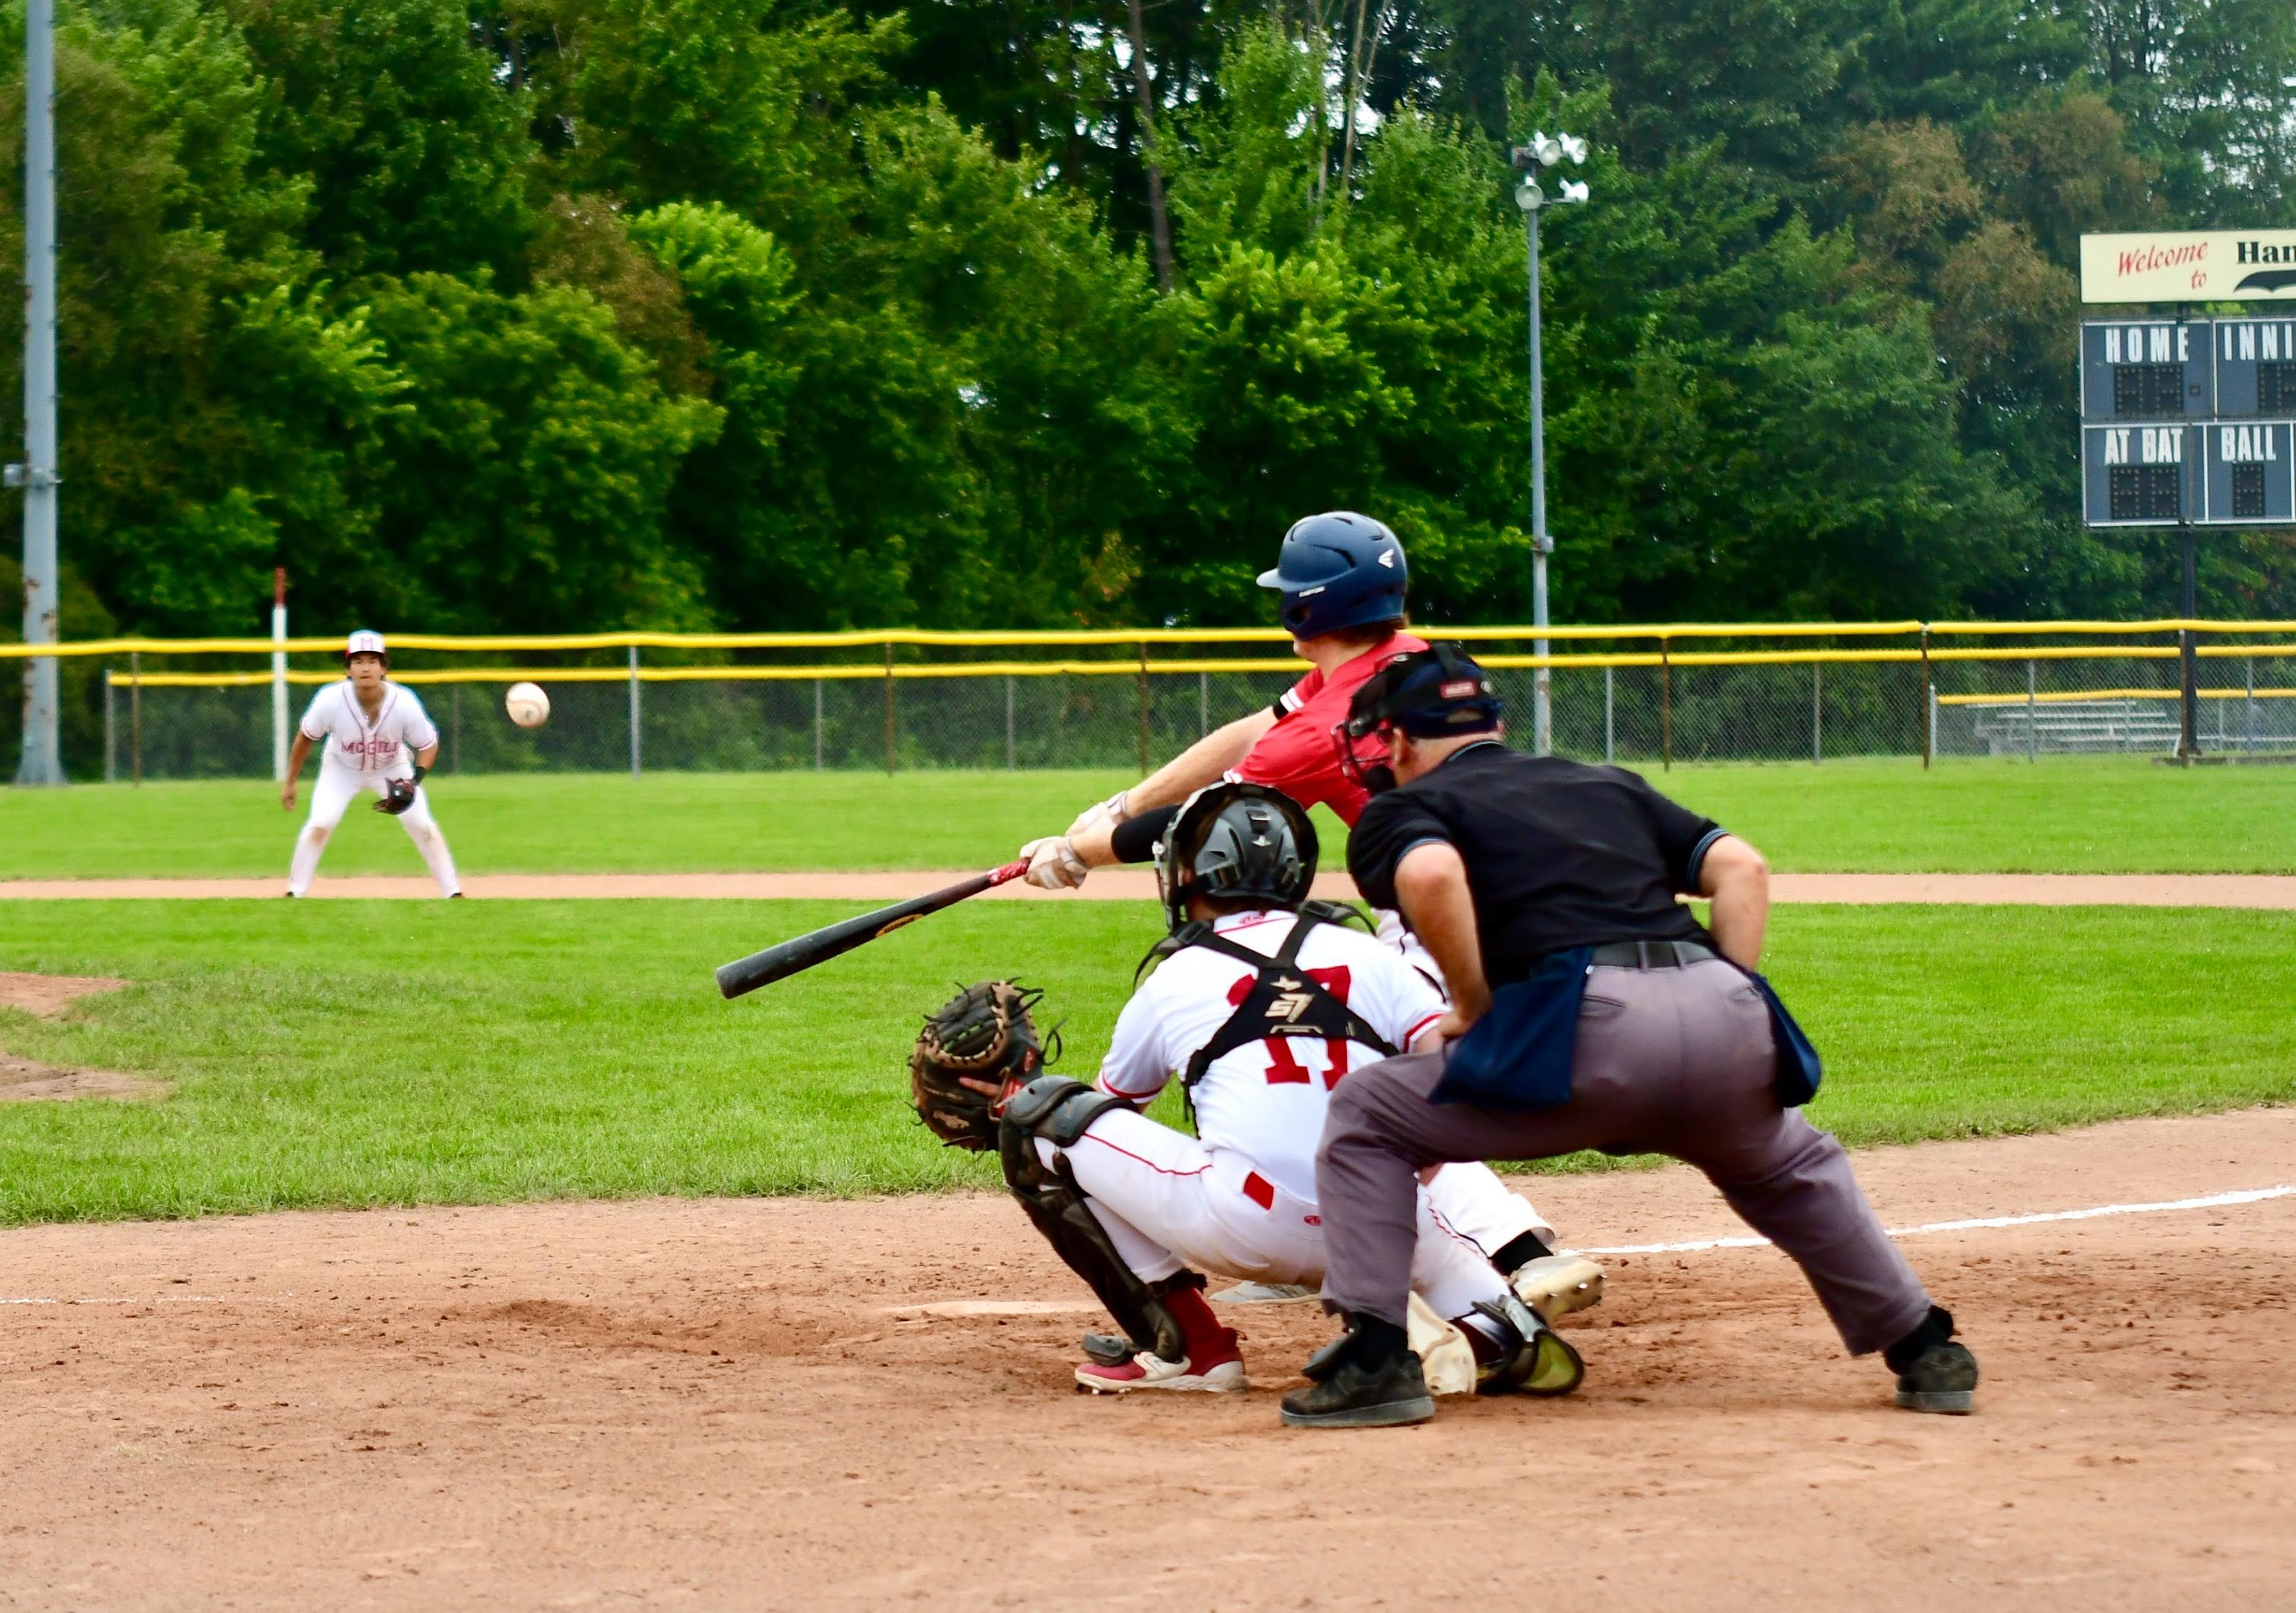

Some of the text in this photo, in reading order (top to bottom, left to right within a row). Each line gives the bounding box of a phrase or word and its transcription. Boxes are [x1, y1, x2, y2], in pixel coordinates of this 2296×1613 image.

[2118, 242, 2208, 278] Welcome
[2191, 269, 2208, 290] to
[2105, 326, 2189, 363] HOME
[2224, 323, 2293, 361] INNI
[2104, 428, 2184, 464] AT BAT
[2221, 426, 2277, 463] BALL
